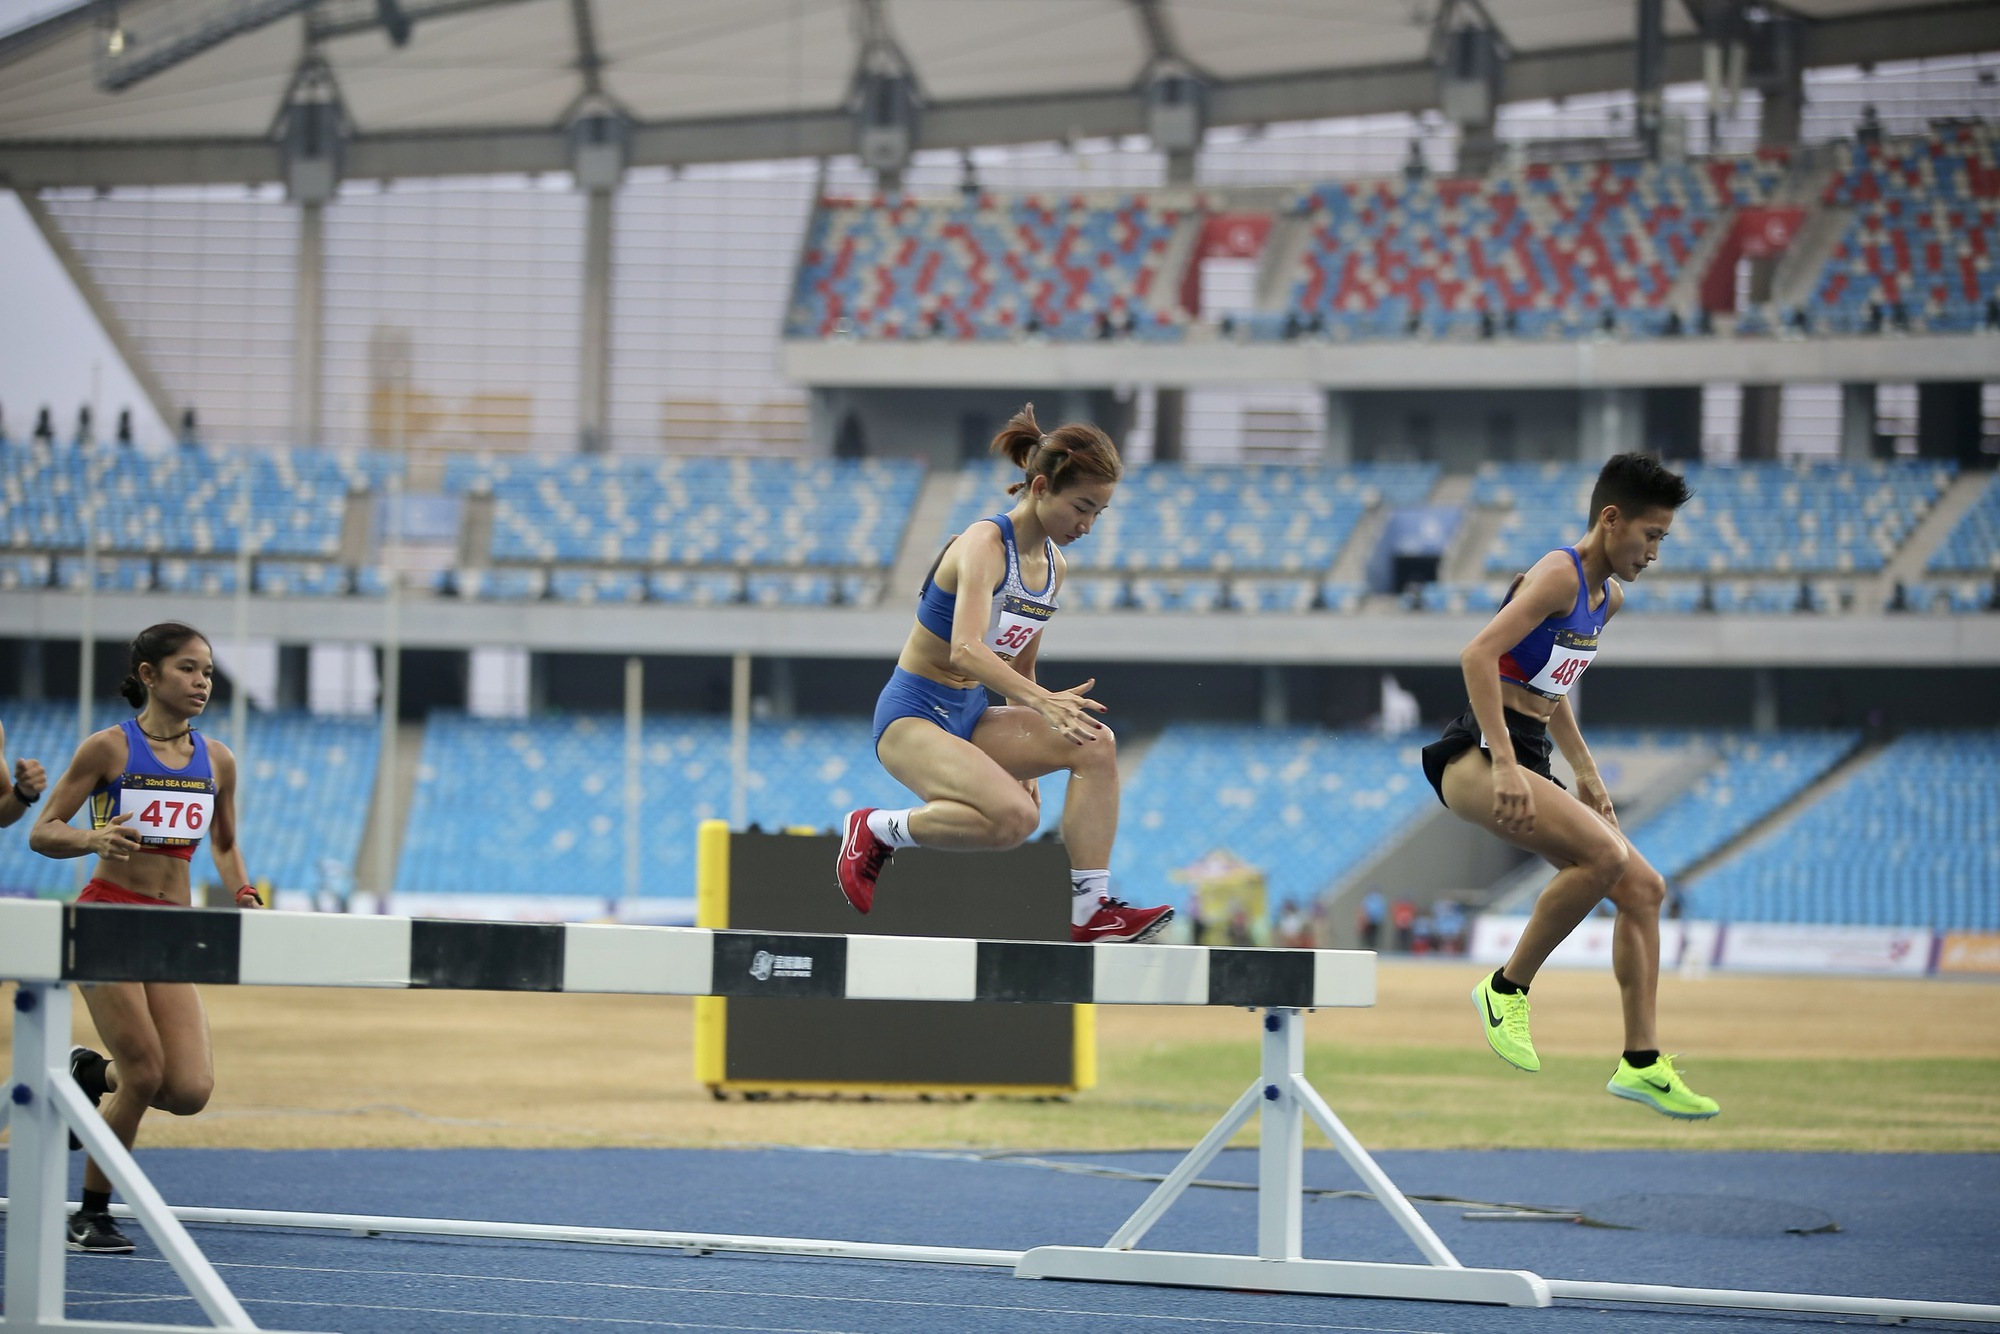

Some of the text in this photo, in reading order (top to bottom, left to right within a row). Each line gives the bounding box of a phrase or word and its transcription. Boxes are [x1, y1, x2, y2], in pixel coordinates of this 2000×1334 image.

[995, 624, 1036, 649] 56
[1550, 657, 1589, 686] 487
[145, 778, 206, 790] 32nd SEA GAMES
[139, 800, 204, 830] 476
